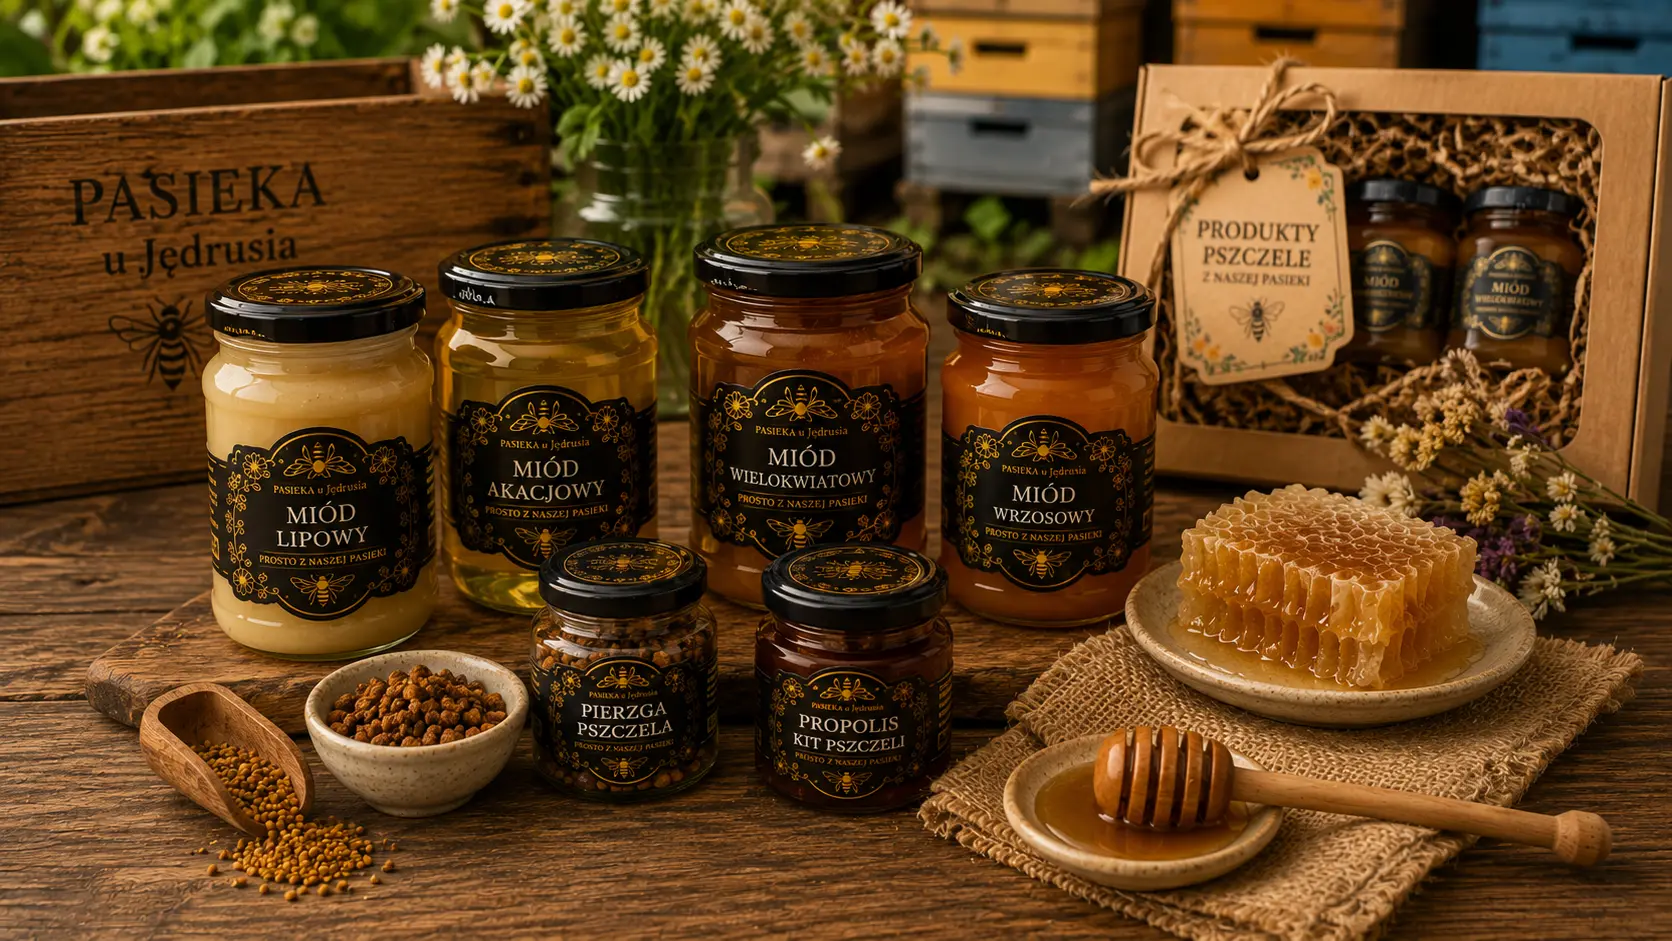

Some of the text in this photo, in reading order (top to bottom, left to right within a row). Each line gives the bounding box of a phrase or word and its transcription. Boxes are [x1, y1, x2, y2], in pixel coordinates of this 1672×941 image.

[69, 161, 327, 226] PASIEKA
[1196, 219, 1320, 243] PRODUKTY
[102, 228, 298, 280] u Jędrusia
[1203, 246, 1312, 268] PSZCZELE
[1202, 271, 1311, 287] Z NASZEJ PASIEKI
[1491, 279, 1530, 295] MIÓD
[755, 425, 848, 439] PASIEKA u Jędrusia
[500, 439, 539, 450] PASIEKA
[550, 437, 590, 451] Jędrusia
[767, 444, 836, 467] MIÓD
[512, 455, 579, 478] MIÓD
[1001, 464, 1039, 476] PASIEKA
[730, 466, 876, 489] WIELOKWIATOWY
[273, 480, 367, 496] PASIEKA u Jędrusia
[488, 479, 605, 503] AKACJOWY
[1011, 482, 1076, 504] MIÓD
[485, 504, 609, 519] PROSTO Z NASZEJ PASIEKI
[737, 493, 868, 510] PROSTO Z NASZEJ PASIEKI
[286, 500, 356, 525] MIÓD
[993, 506, 1096, 525] WRZOSOWY
[276, 525, 369, 548] LIPOWY
[985, 526, 1019, 540] PROSTO
[1021, 532, 1028, 541] Z
[1030, 533, 1065, 543] NASZEJ
[259, 548, 387, 567] PROSTO Z NASZEJ PASIEKI
[581, 701, 667, 720] PIERZGA
[577, 719, 673, 738] PSZCZELA
[799, 713, 899, 734] PROPOLIS
[793, 732, 906, 753] KIT PSZCZELI
